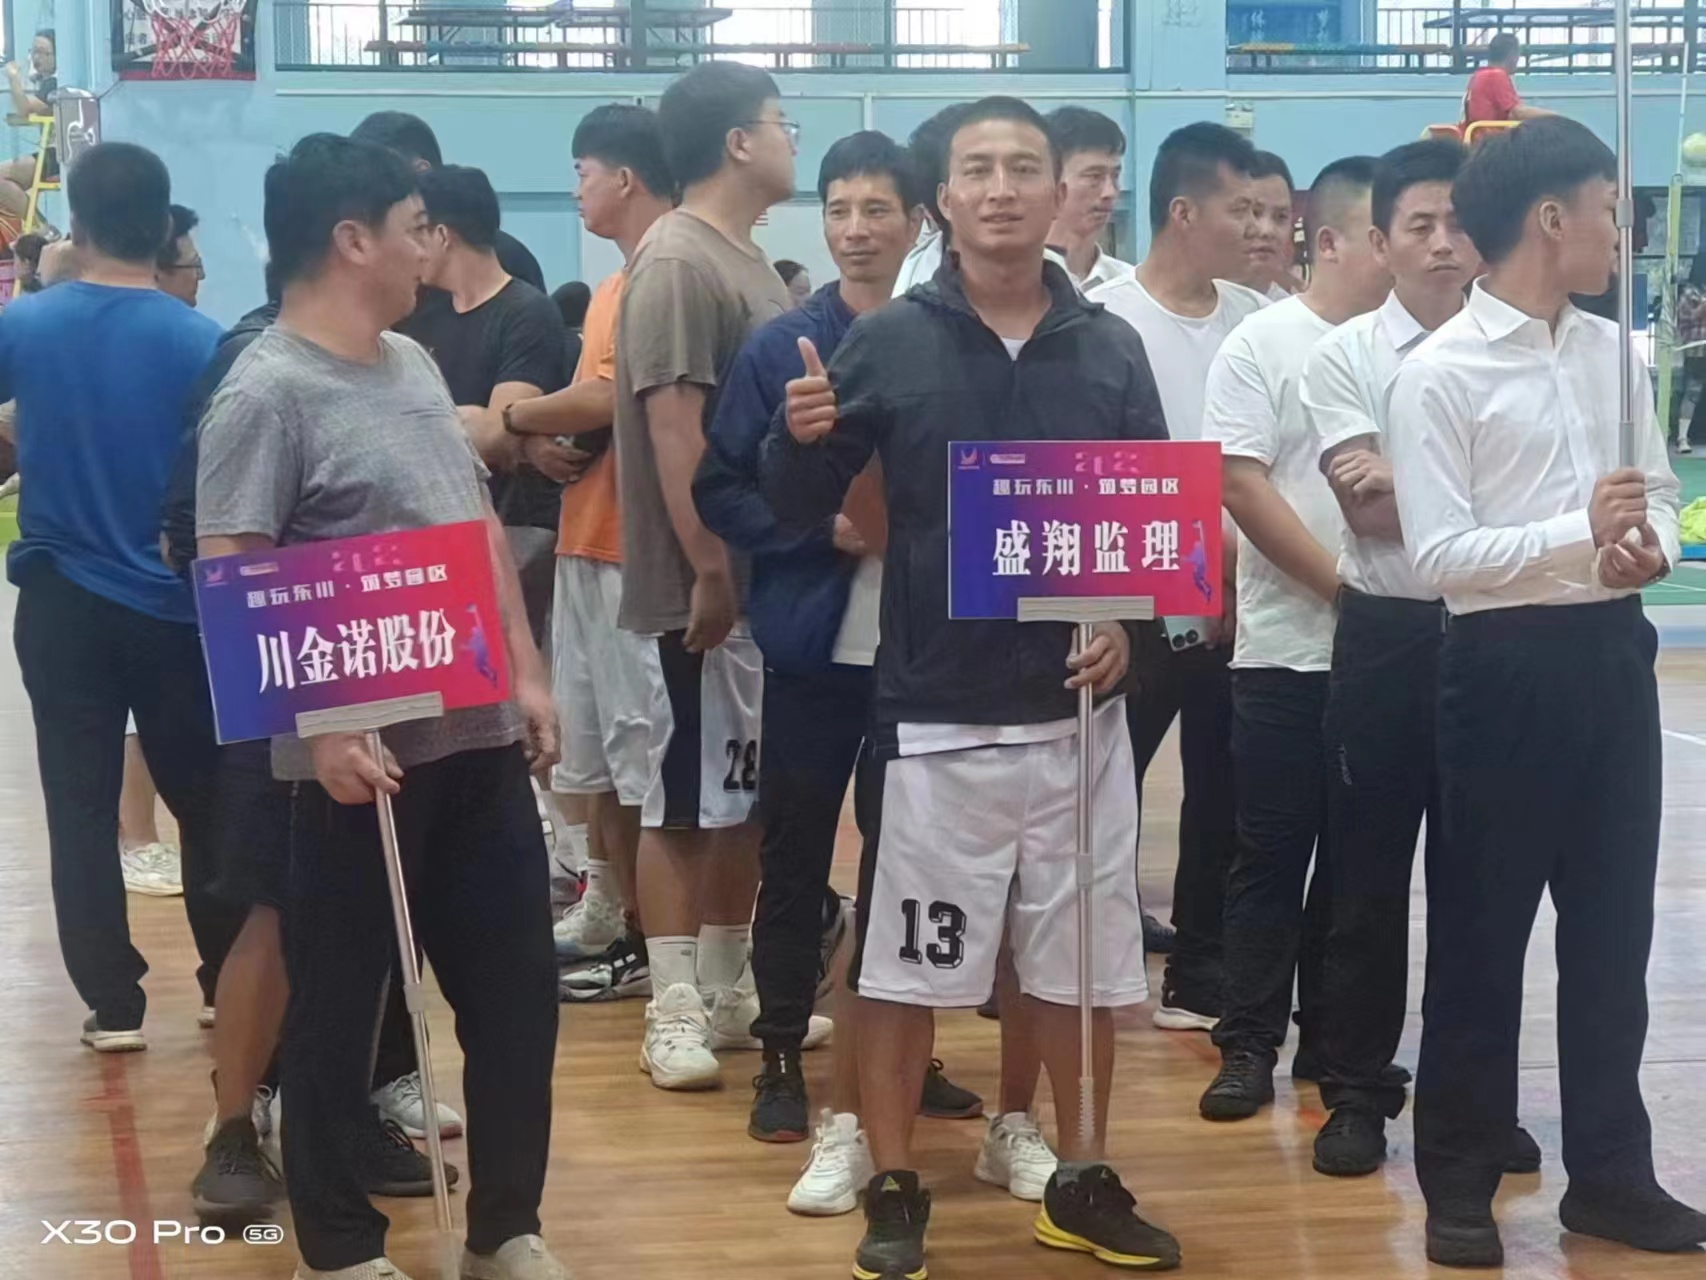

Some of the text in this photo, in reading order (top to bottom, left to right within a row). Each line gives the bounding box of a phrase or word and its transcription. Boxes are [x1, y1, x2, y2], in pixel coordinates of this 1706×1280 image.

[992, 519, 1180, 576] 盛翔监理
[256, 608, 457, 694] 川金诺股份
[899, 898, 967, 969] 13
